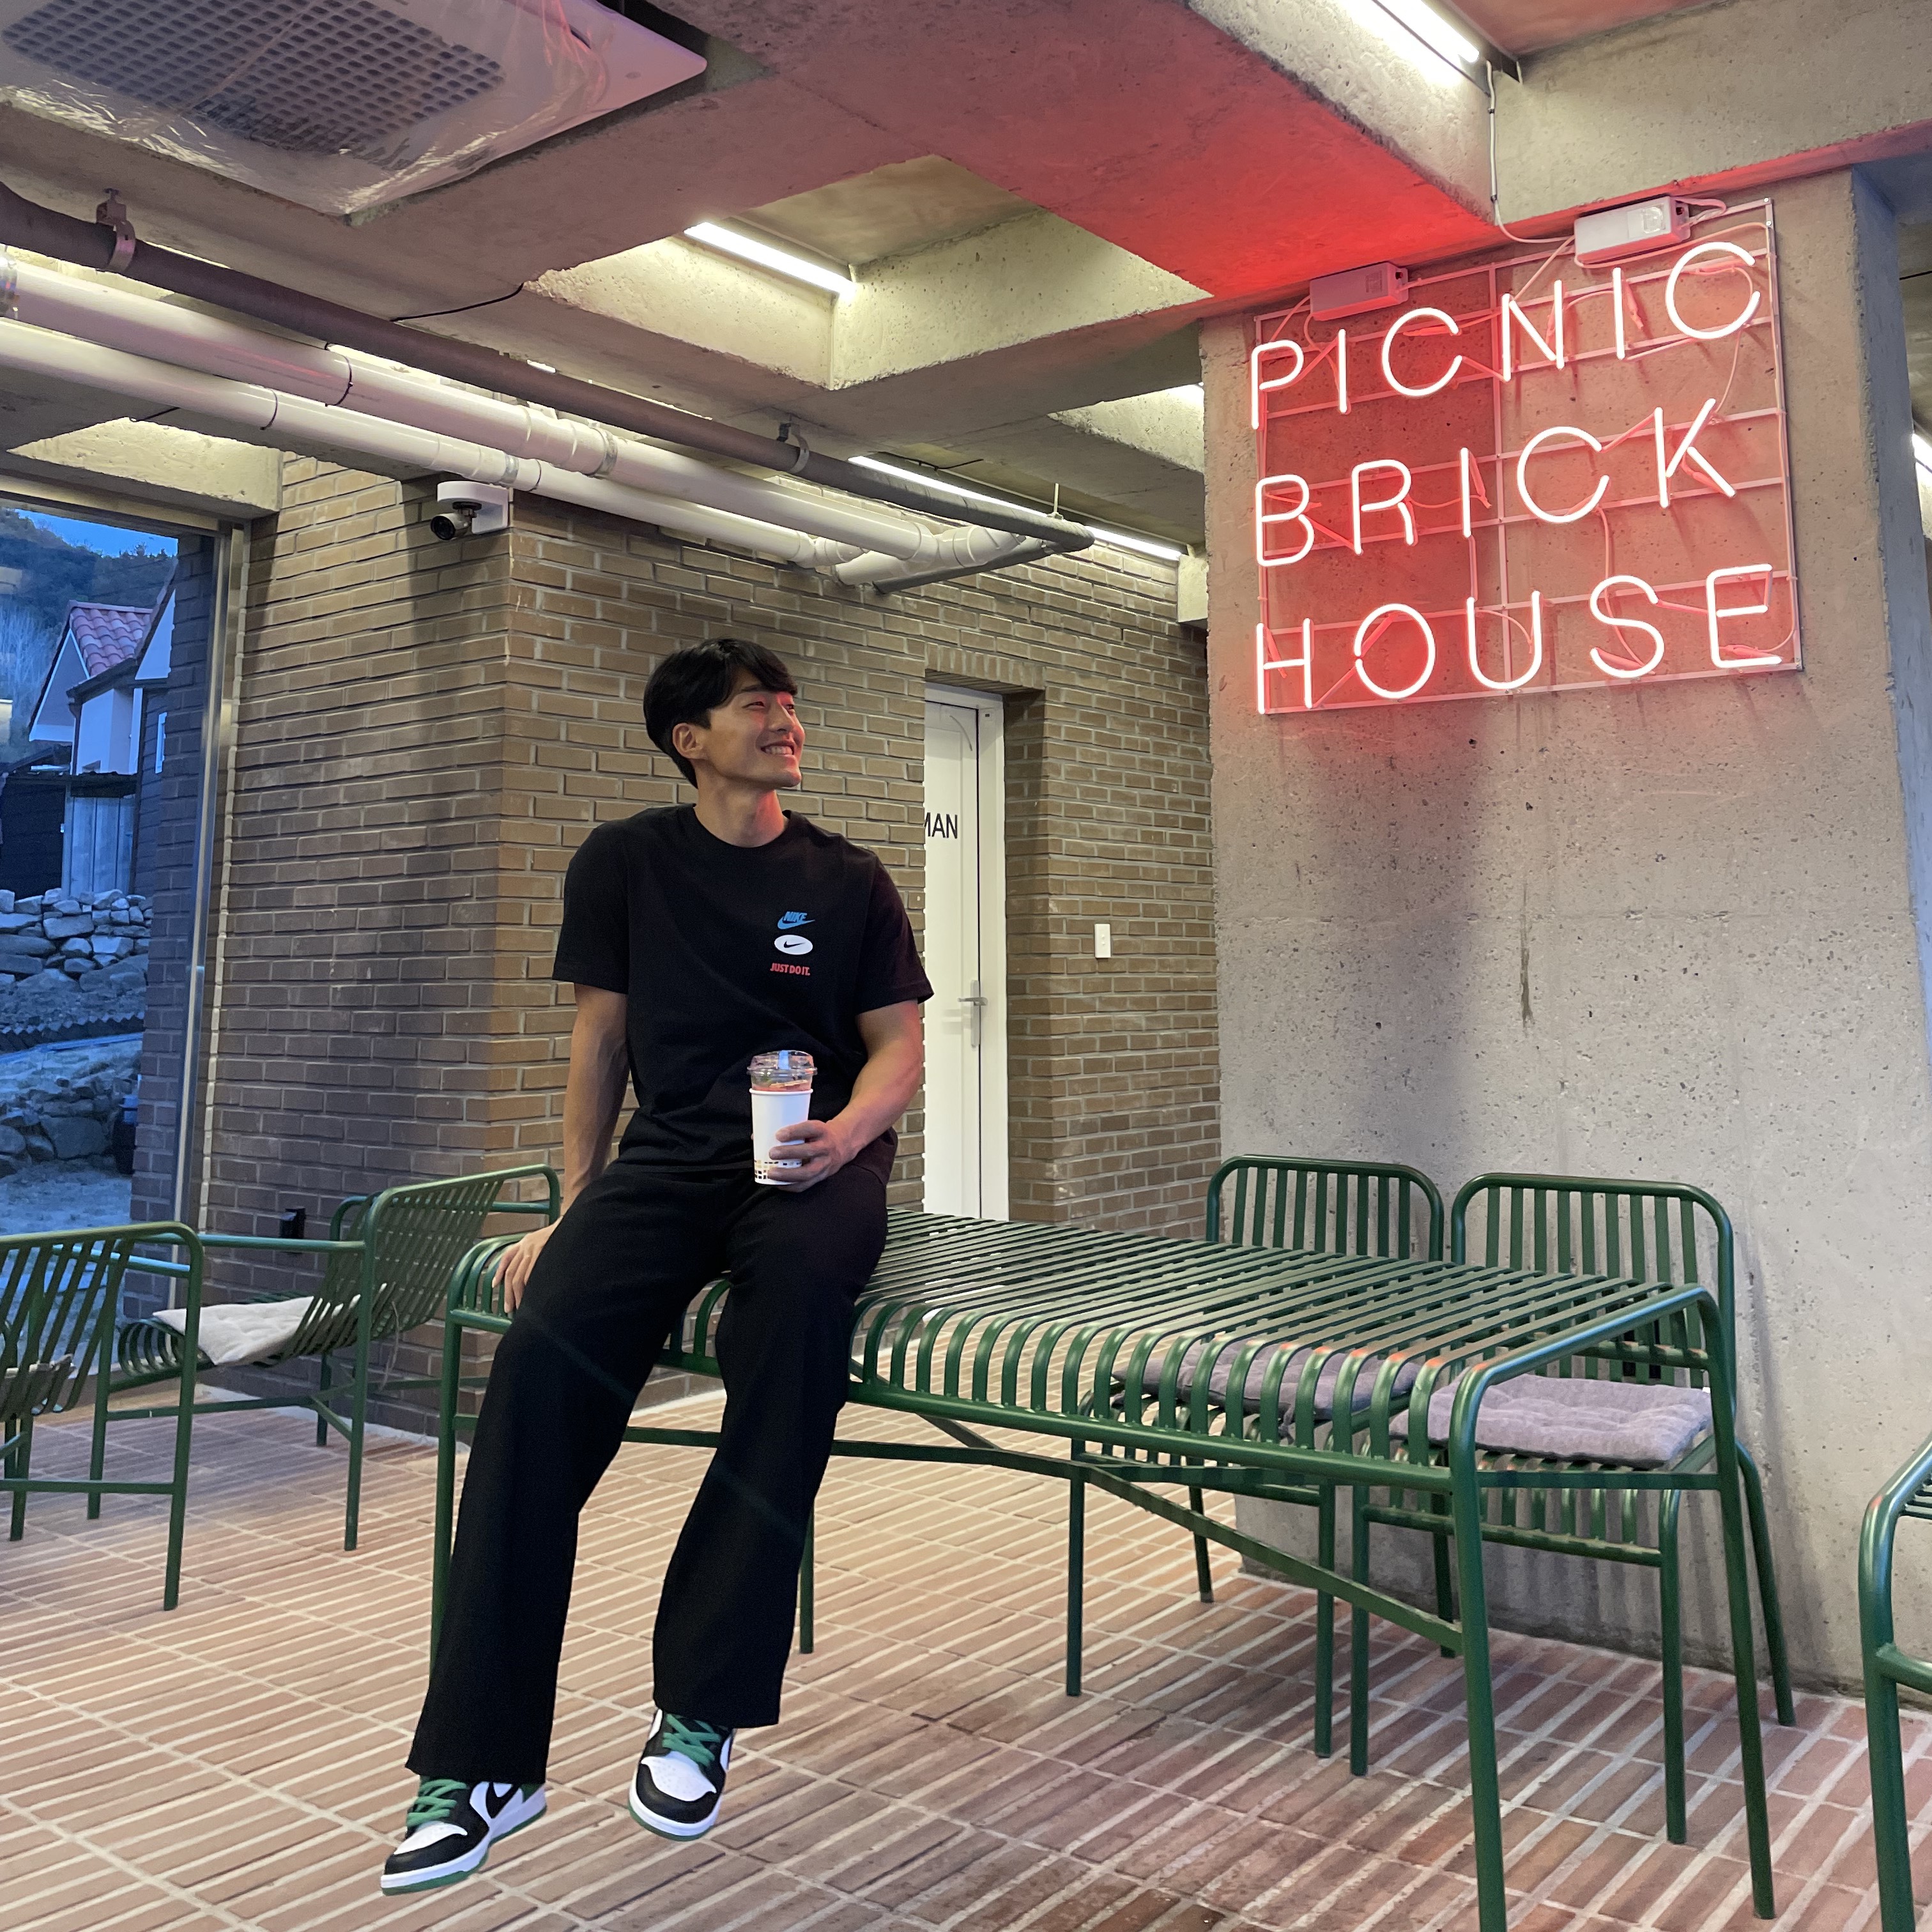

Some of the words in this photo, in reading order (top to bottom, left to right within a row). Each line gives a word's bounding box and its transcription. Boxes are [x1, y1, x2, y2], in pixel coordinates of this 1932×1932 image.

[1251, 241, 1761, 429] PICNIC
[1255, 398, 1736, 567] BRICK
[1256, 564, 1782, 714] HOUSE
[770, 962, 790, 973] JUST
[789, 965, 801, 975] DO
[783, 911, 808, 921] NIKE
